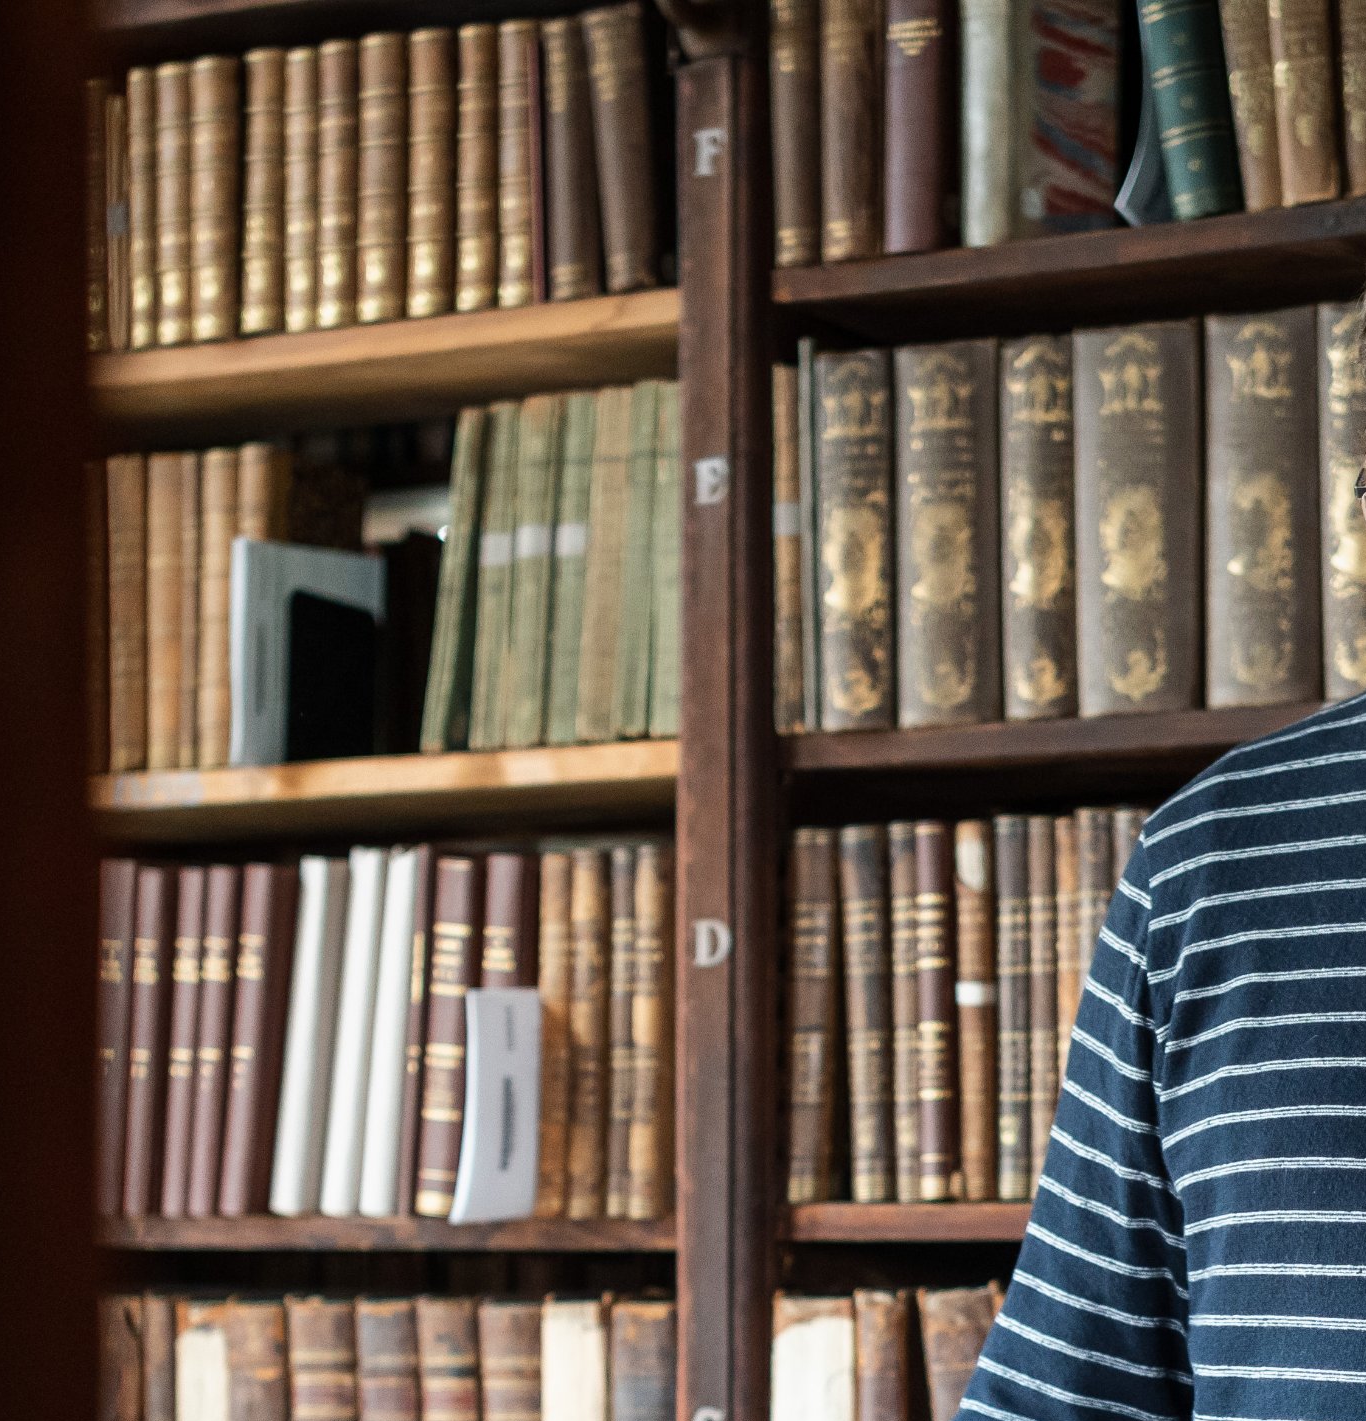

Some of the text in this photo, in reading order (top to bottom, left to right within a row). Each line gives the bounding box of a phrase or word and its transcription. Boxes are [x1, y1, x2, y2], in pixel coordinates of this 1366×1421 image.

[694, 128, 726, 176] F
[695, 456, 729, 504] E
[693, 918, 731, 966] D
